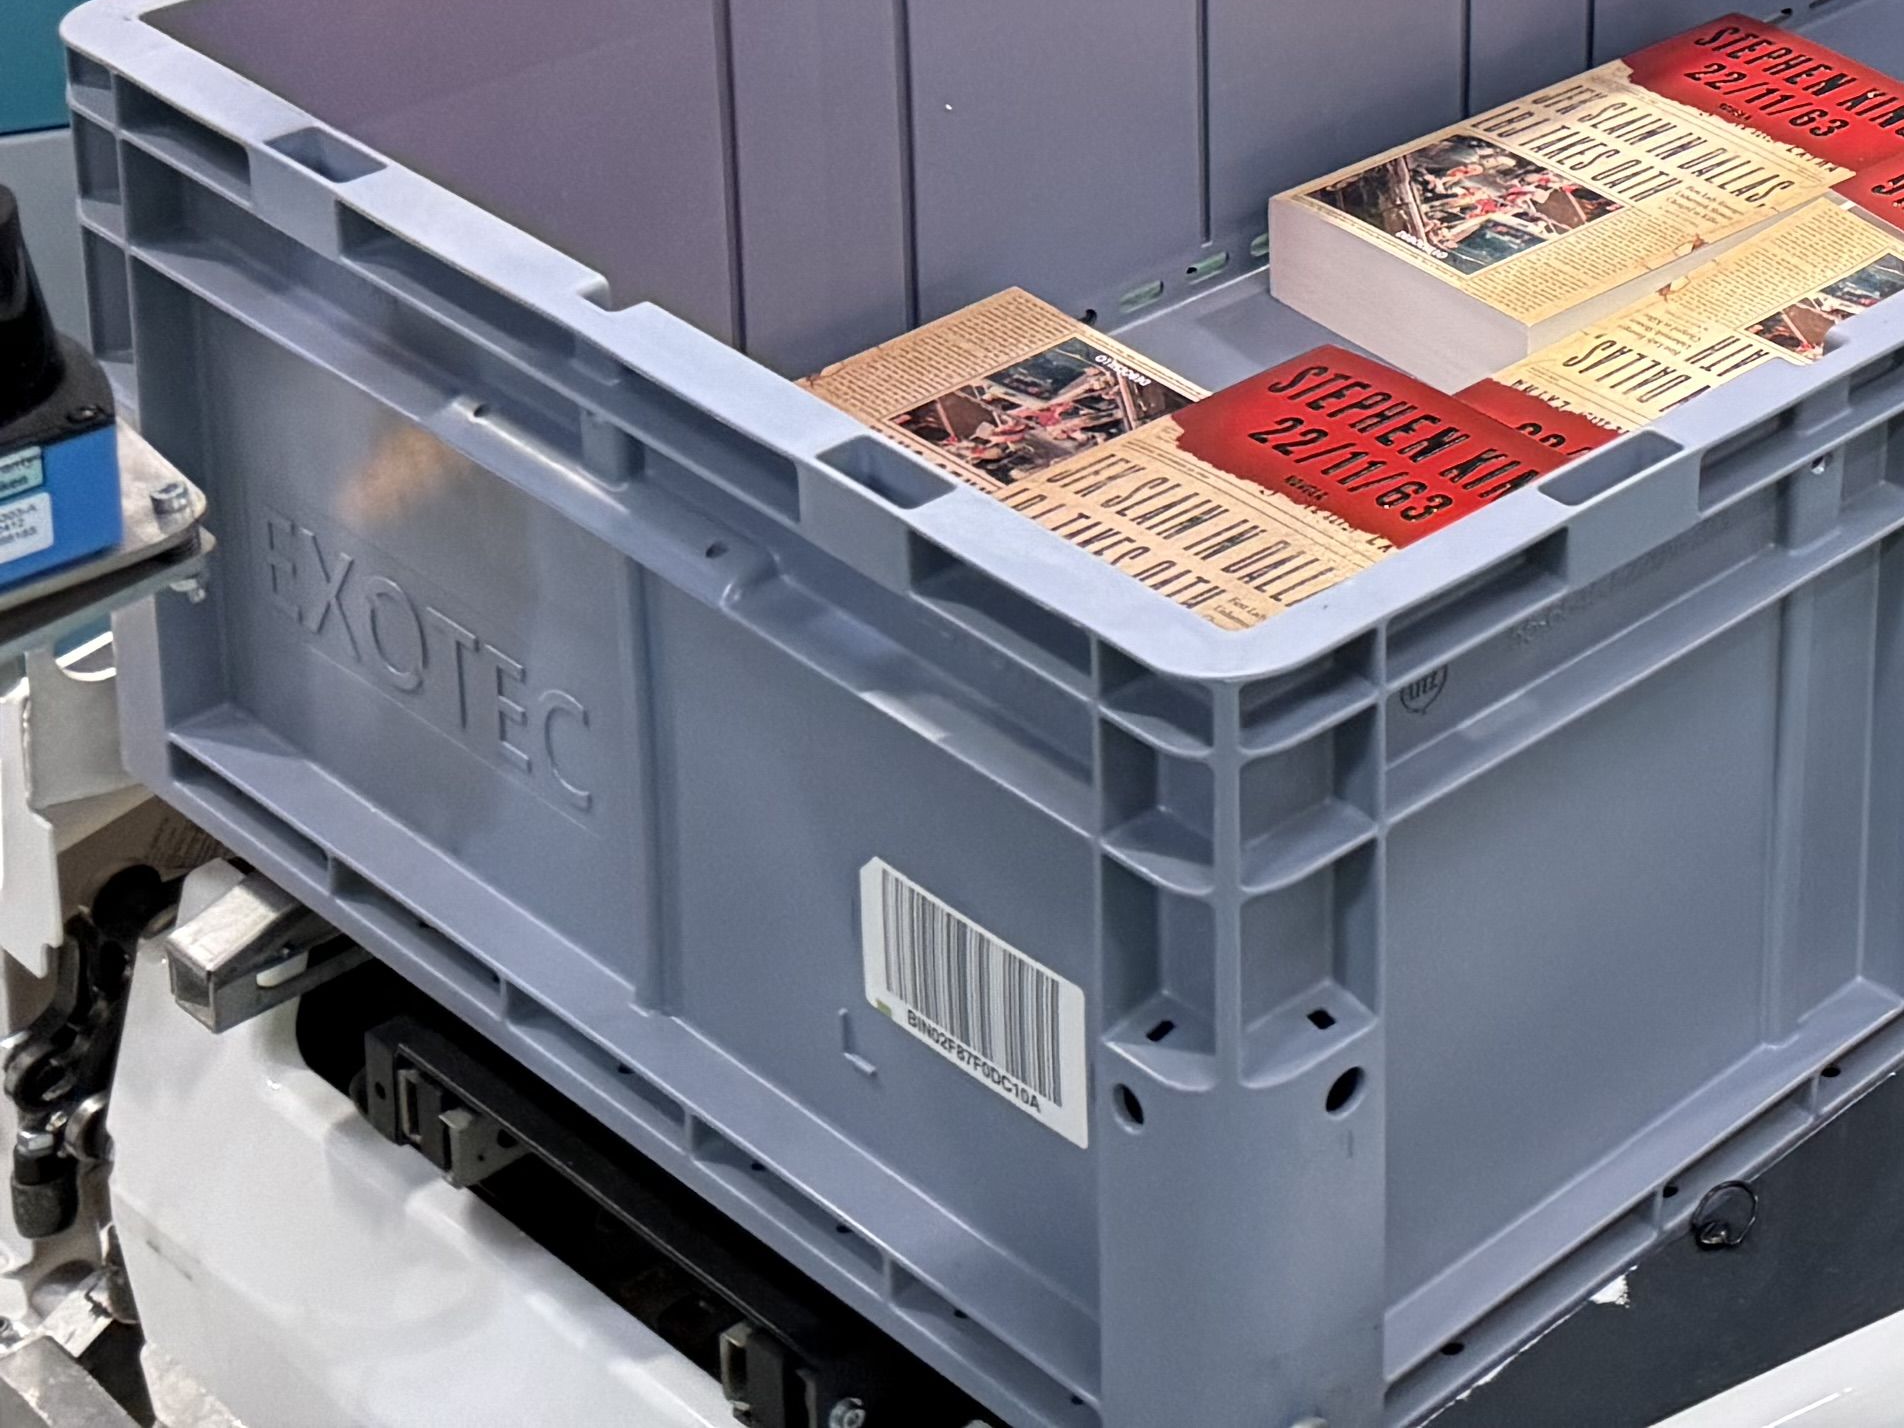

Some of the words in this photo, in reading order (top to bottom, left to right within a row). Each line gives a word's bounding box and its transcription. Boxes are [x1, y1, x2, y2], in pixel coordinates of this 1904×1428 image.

[1684, 62, 1849, 137] 22/11/63
[1694, 26, 1857, 95] STEPHEN
[1471, 106, 1549, 138] LBJ
[1518, 124, 1621, 172] TAKES
[1591, 158, 1684, 202] OATH
[1532, 84, 1604, 116] JFK
[1578, 101, 1677, 146] SLAIN
[1647, 132, 1704, 161] IN
[1679, 141, 1795, 208] DALLAS,
[1248, 417, 1454, 522] 22/11/63
[1268, 366, 1471, 463] STEPHEN
[1440, 448, 1541, 499] KIN
[1046, 454, 1147, 498] JFK
[1101, 476, 1231, 541] SLAIN
[1184, 519, 1267, 561] IN
[1221, 540, 1352, 608] DALL
[266, 519, 594, 814] EXOTEC
[906, 1009, 1042, 1113] BIN02F87F0DC10A
